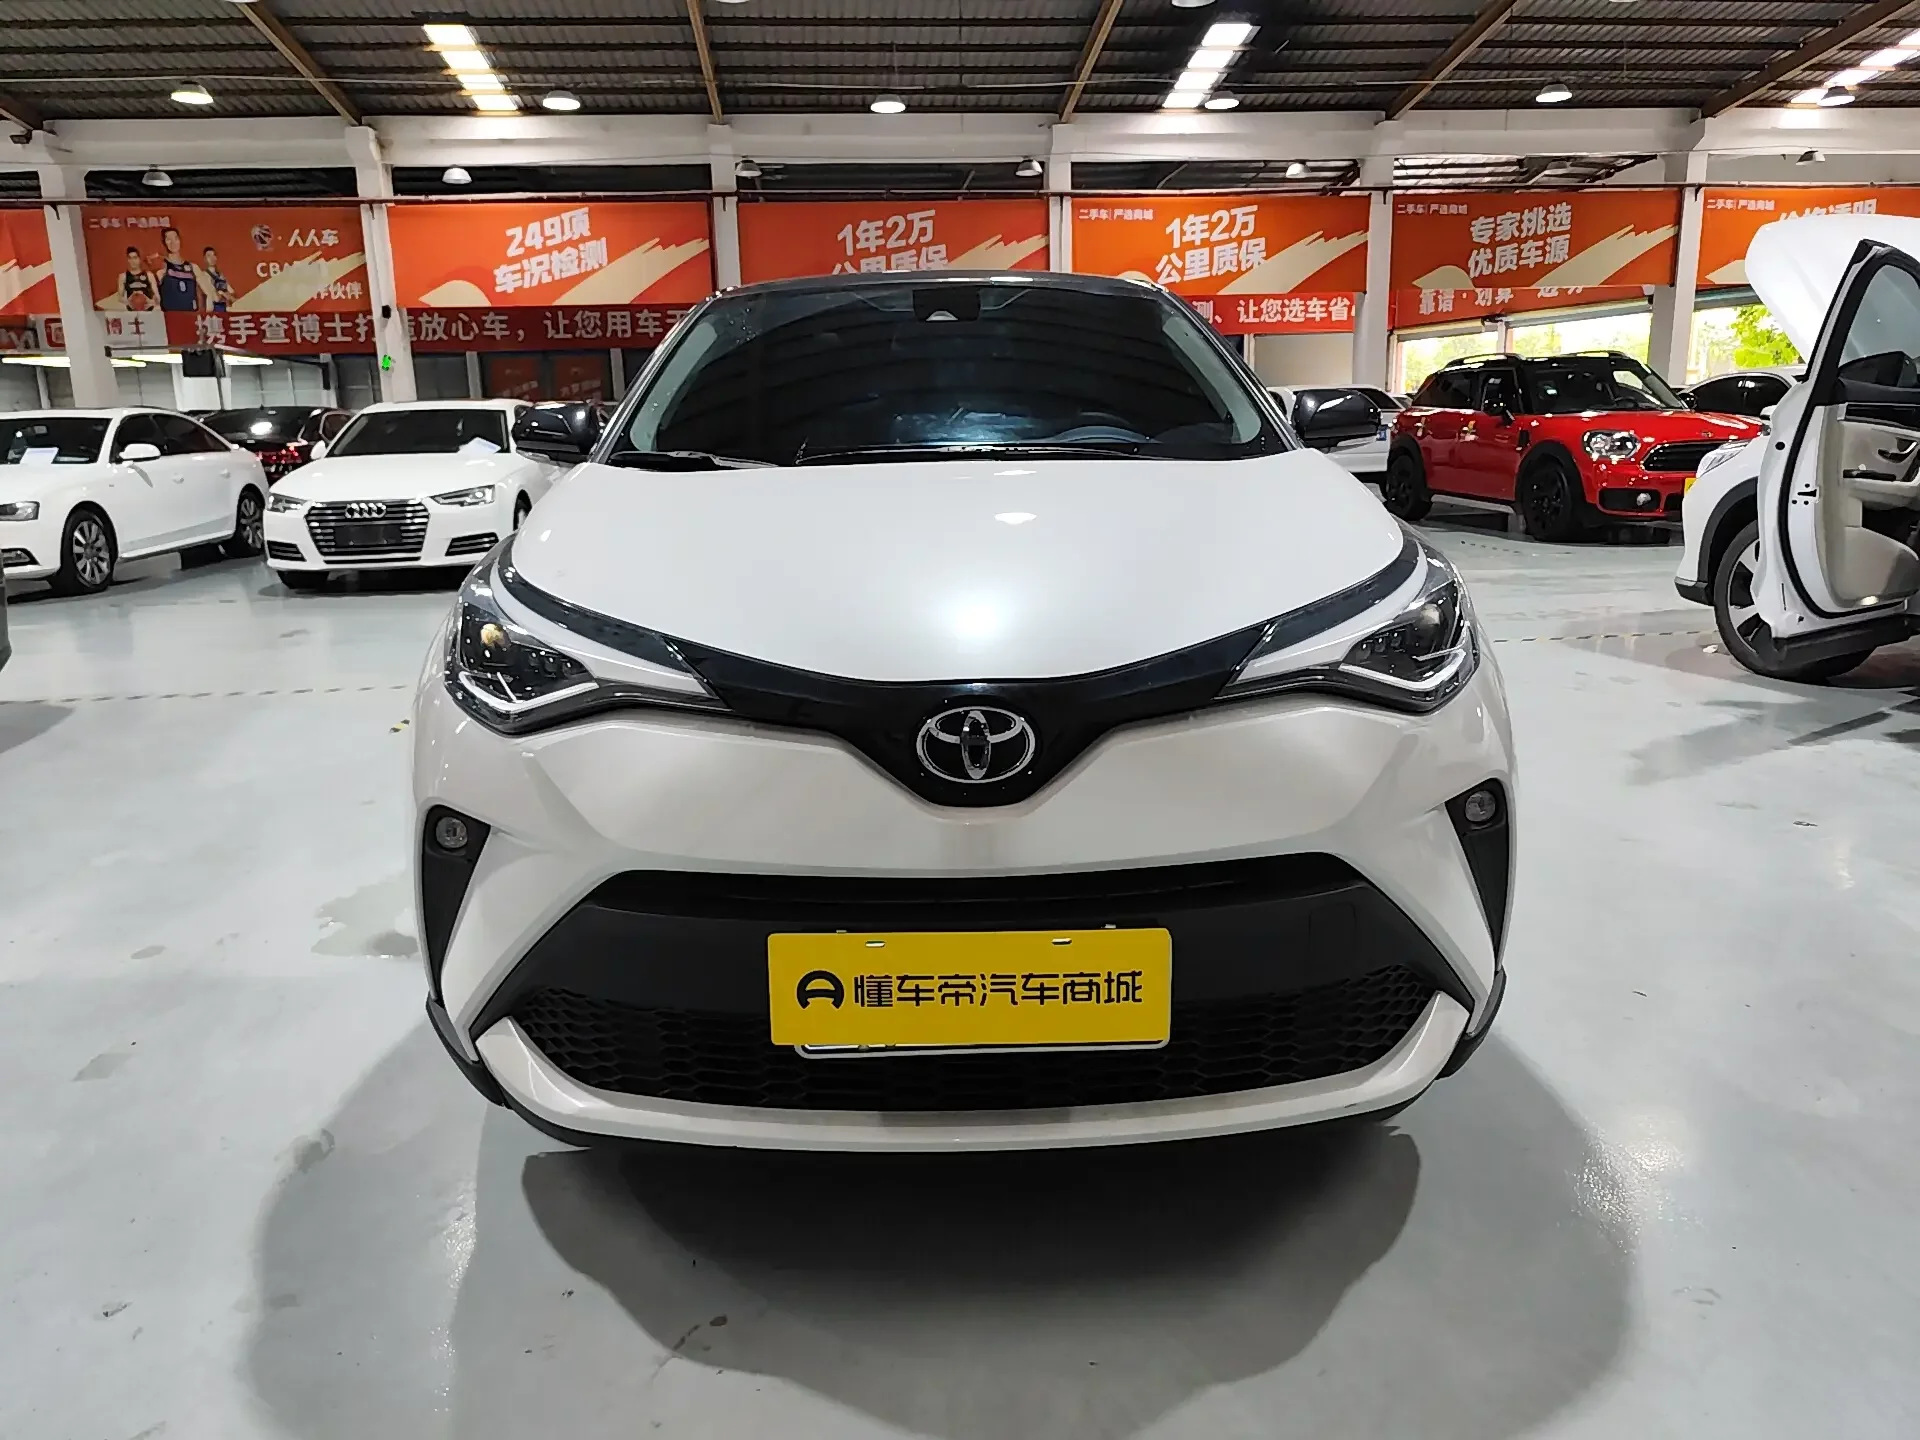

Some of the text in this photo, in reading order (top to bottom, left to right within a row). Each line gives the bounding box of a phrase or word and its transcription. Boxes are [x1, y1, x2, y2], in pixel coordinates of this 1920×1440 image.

[288, 229, 340, 247] 人人车
[505, 206, 591, 258] 249项
[837, 209, 936, 256] 1年2万
[1165, 205, 1258, 249] 1年2万
[1469, 201, 1572, 244] 专家挑选
[493, 237, 608, 293] 车况检测
[1155, 237, 1267, 285] 公里质保
[1467, 233, 1571, 279] 优质车源
[853, 970, 1143, 1008] 懂车帝汽车商城
